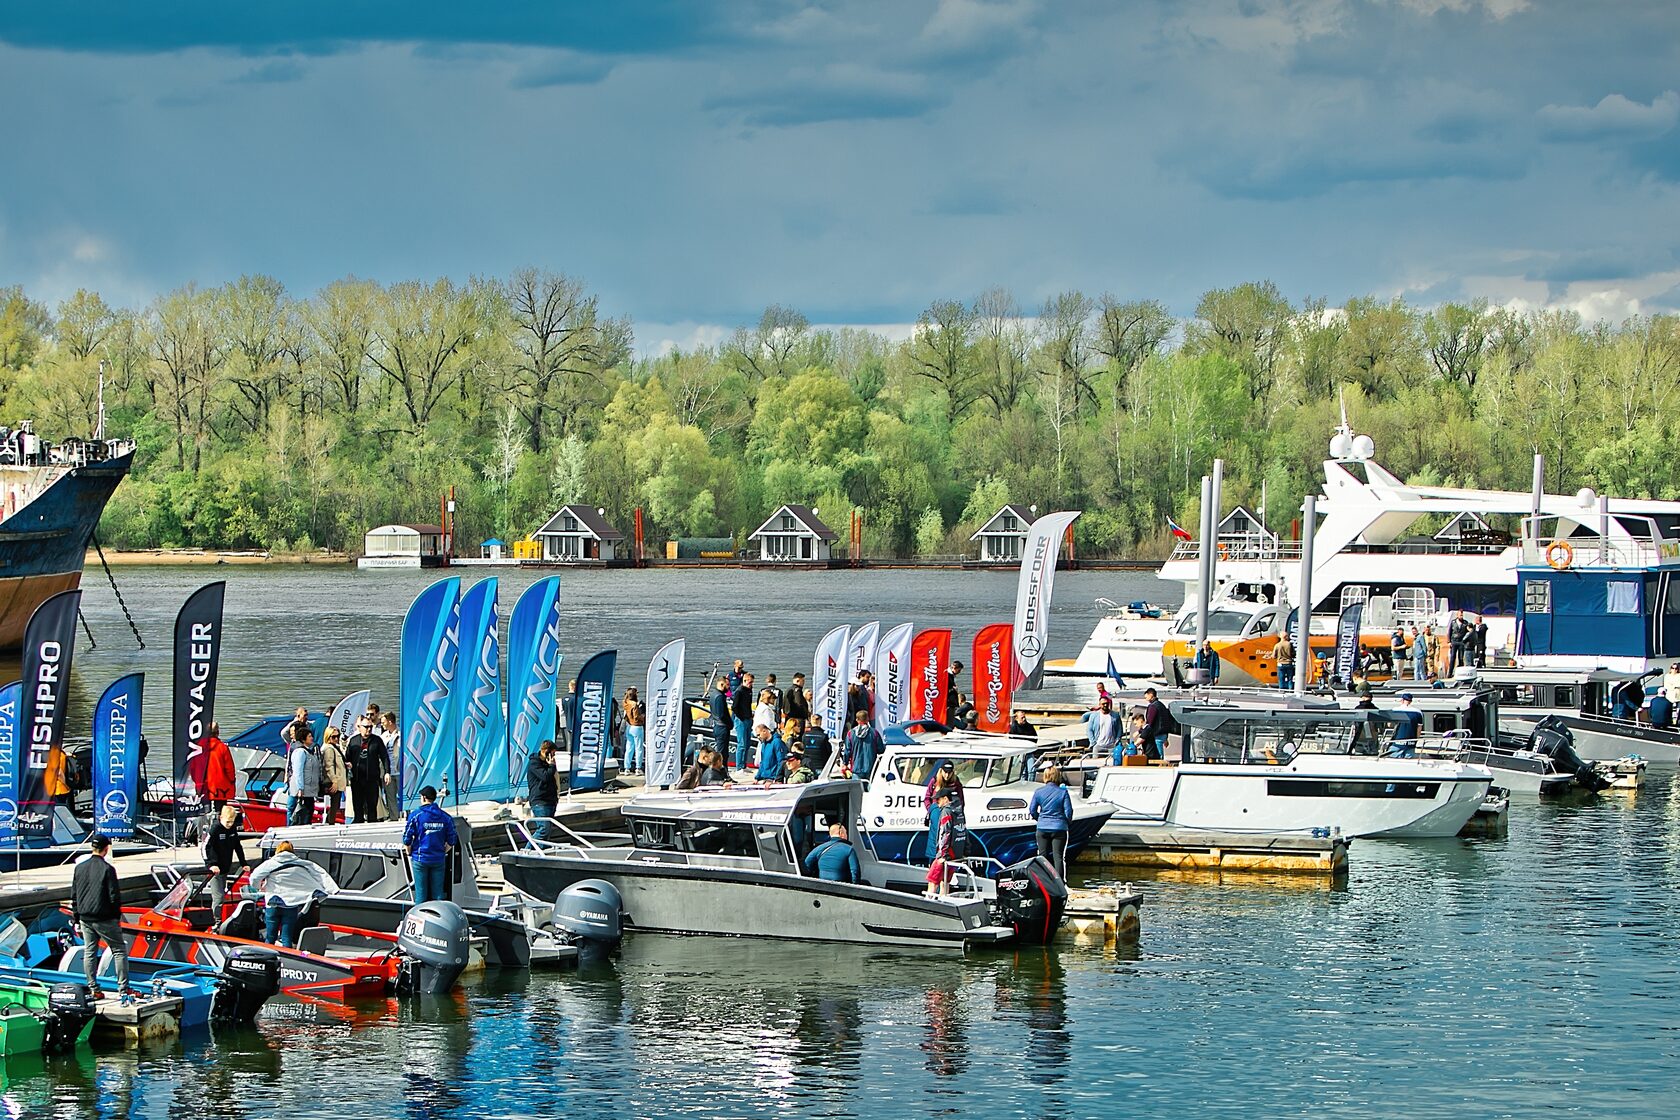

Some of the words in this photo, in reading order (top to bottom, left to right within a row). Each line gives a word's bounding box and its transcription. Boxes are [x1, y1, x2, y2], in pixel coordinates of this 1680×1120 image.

[1025, 536, 1048, 632] BOSSFORR
[29, 641, 61, 769] FISHPRO
[186, 622, 212, 761] VOYAGER
[888, 662, 898, 727] EARENE
[922, 647, 940, 722] iverBrothers
[109, 693, 128, 784] ТРИЕРА
[577, 681, 603, 778] MOTORBOAT
[335, 841, 371, 849] VOYAGER
[405, 920, 417, 936] 28
[425, 935, 448, 948] YAMAHA
[586, 912, 609, 921] YAMAHA
[231, 960, 266, 971] SUZUKI
[304, 971, 318, 982] X7
